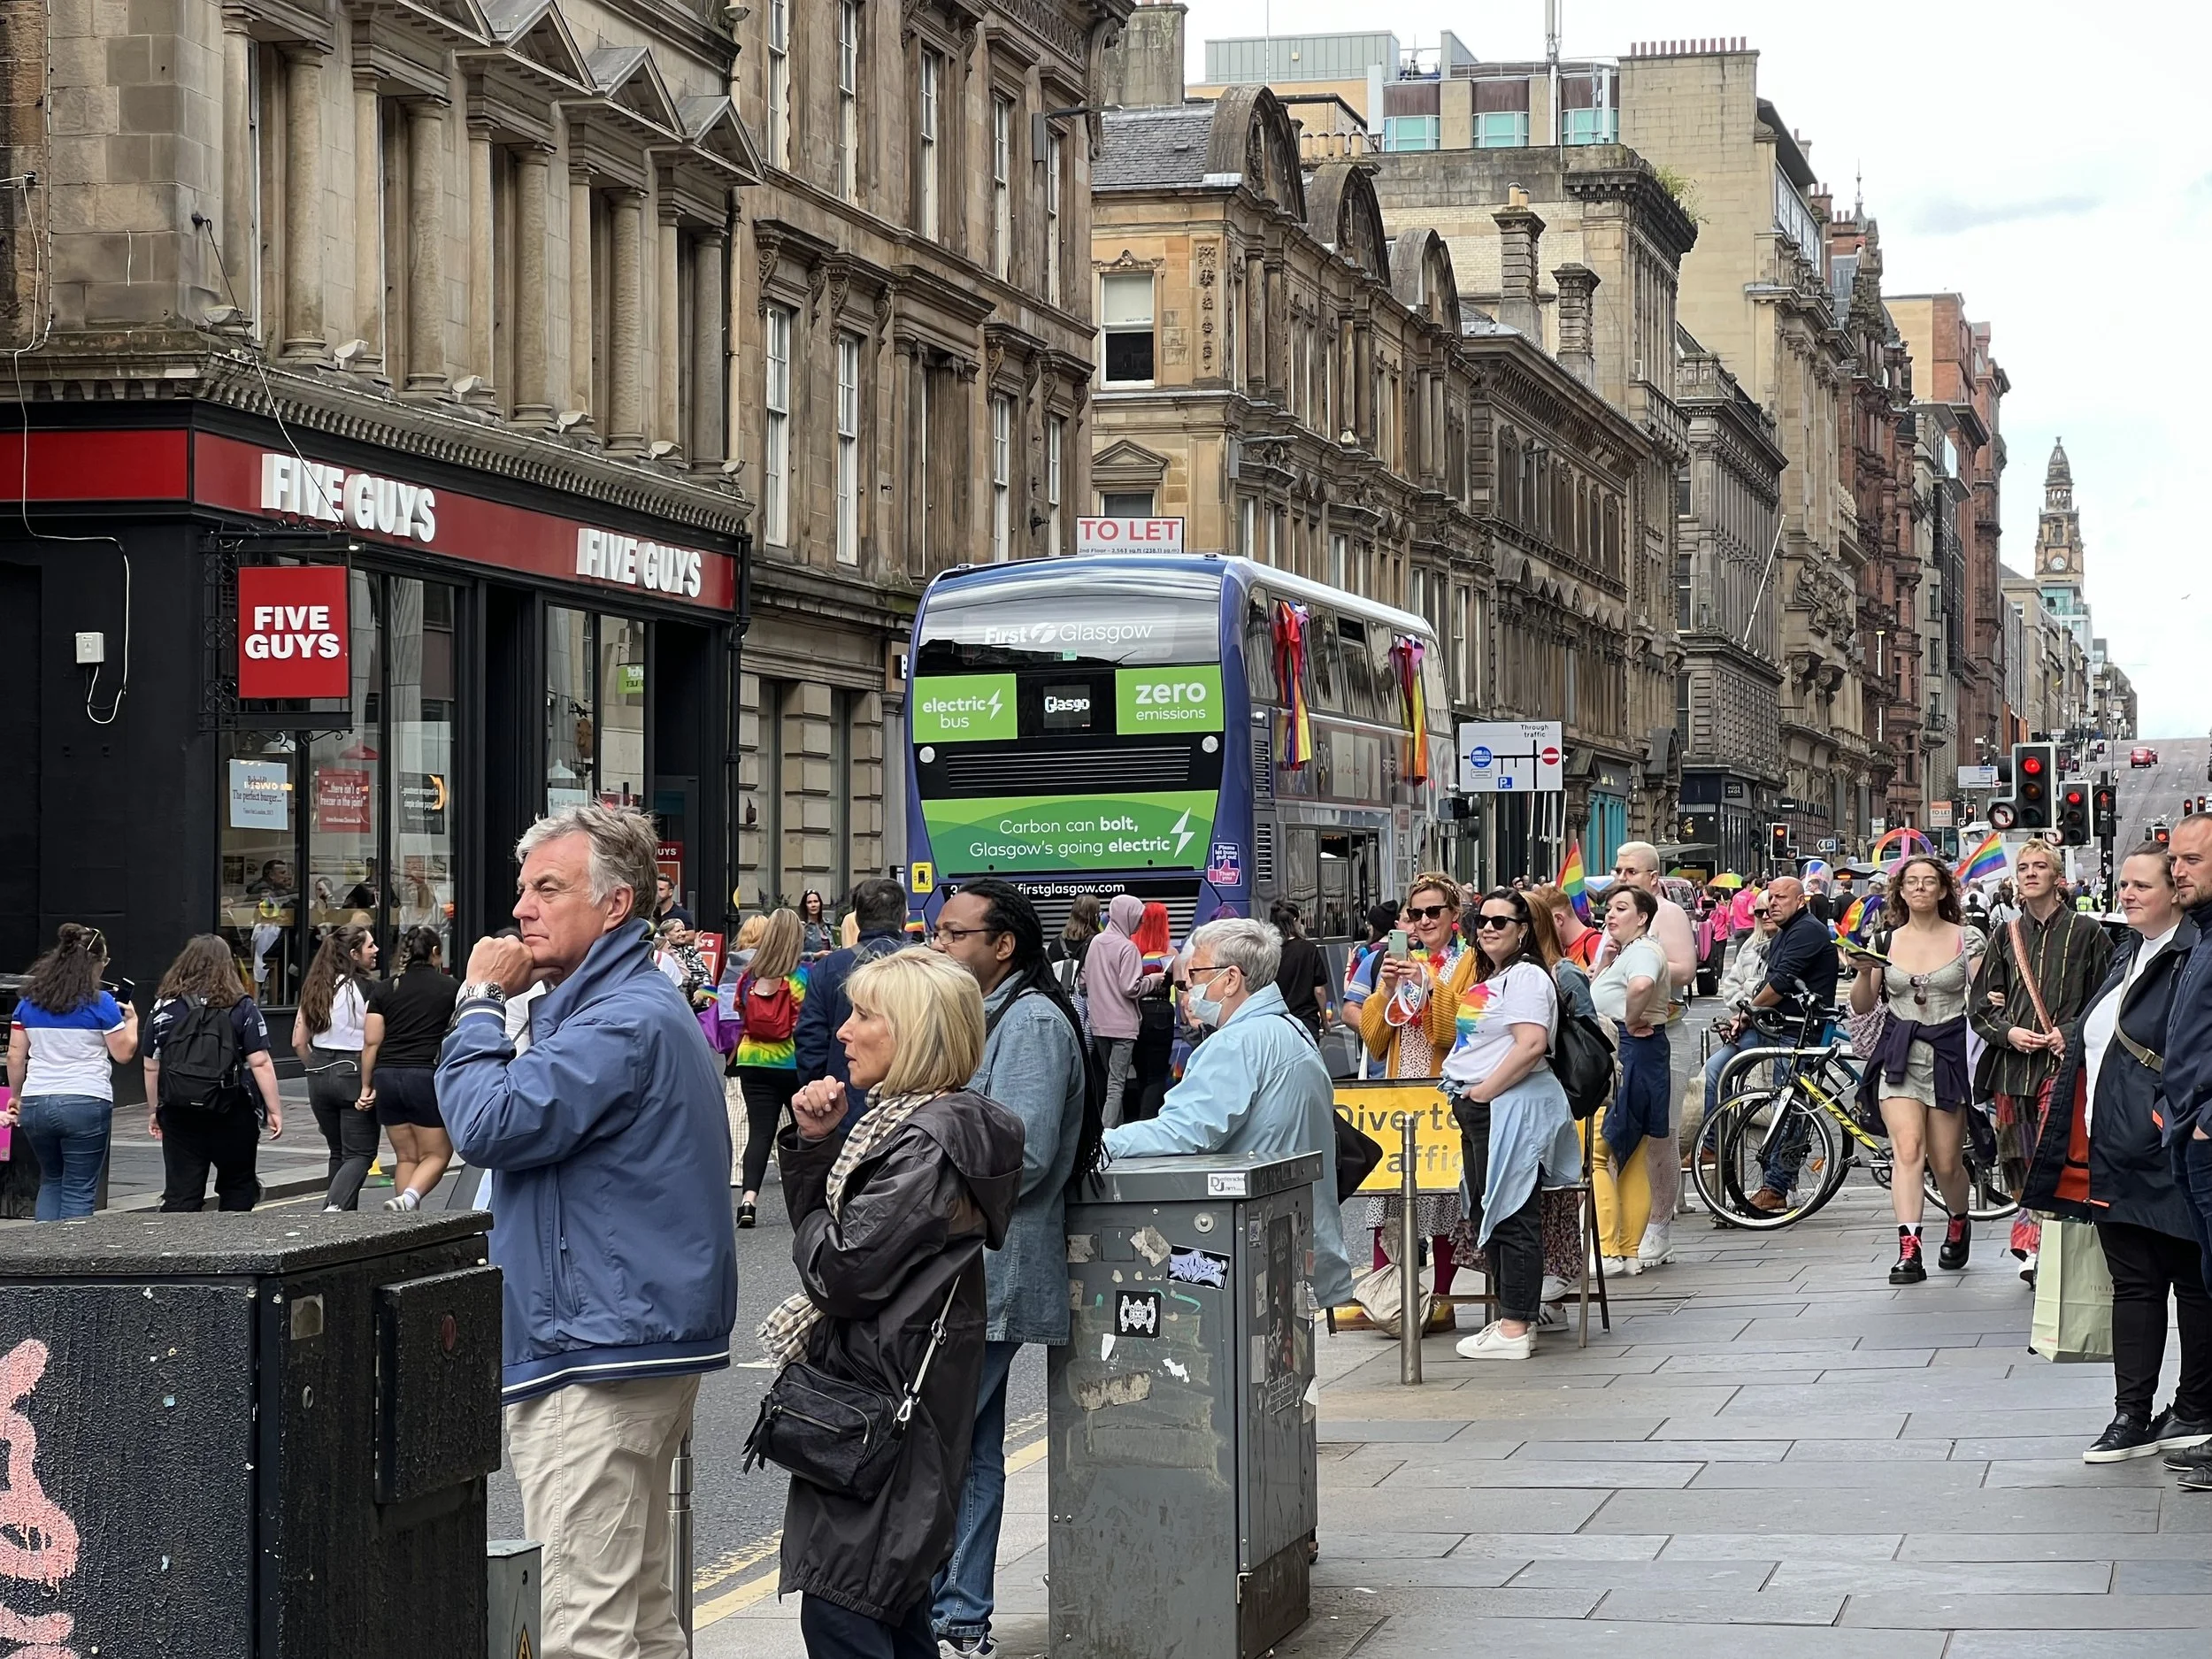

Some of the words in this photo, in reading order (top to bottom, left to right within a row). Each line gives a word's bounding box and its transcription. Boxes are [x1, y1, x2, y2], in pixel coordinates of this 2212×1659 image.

[261, 453, 344, 522] FIVE
[343, 473, 435, 543] GUYS
[1079, 520, 1118, 541] TO
[1129, 520, 1179, 541] LET
[576, 528, 638, 585] FIVE
[635, 541, 702, 598] GUYS
[254, 606, 330, 631] FIVE
[984, 626, 1027, 643] First
[1060, 624, 1154, 644] Glasgow
[245, 634, 340, 659] GUYS
[1135, 682, 1207, 704] zero
[922, 695, 987, 713] electric
[1136, 706, 1206, 721] emissions
[941, 713, 970, 728] bus
[233, 789, 242, 800] The
[242, 790, 259, 803] perfect
[320, 794, 336, 805] freezer
[336, 795, 342, 805] in
[1000, 819, 1061, 834] Carbon
[1065, 819, 1094, 833] can
[1100, 816, 1139, 833] bolt,
[970, 841, 1053, 859] Glasgow's
[1058, 840, 1103, 858] going
[1108, 836, 1171, 853] electric
[1333, 1102, 1462, 1131] Diverte
